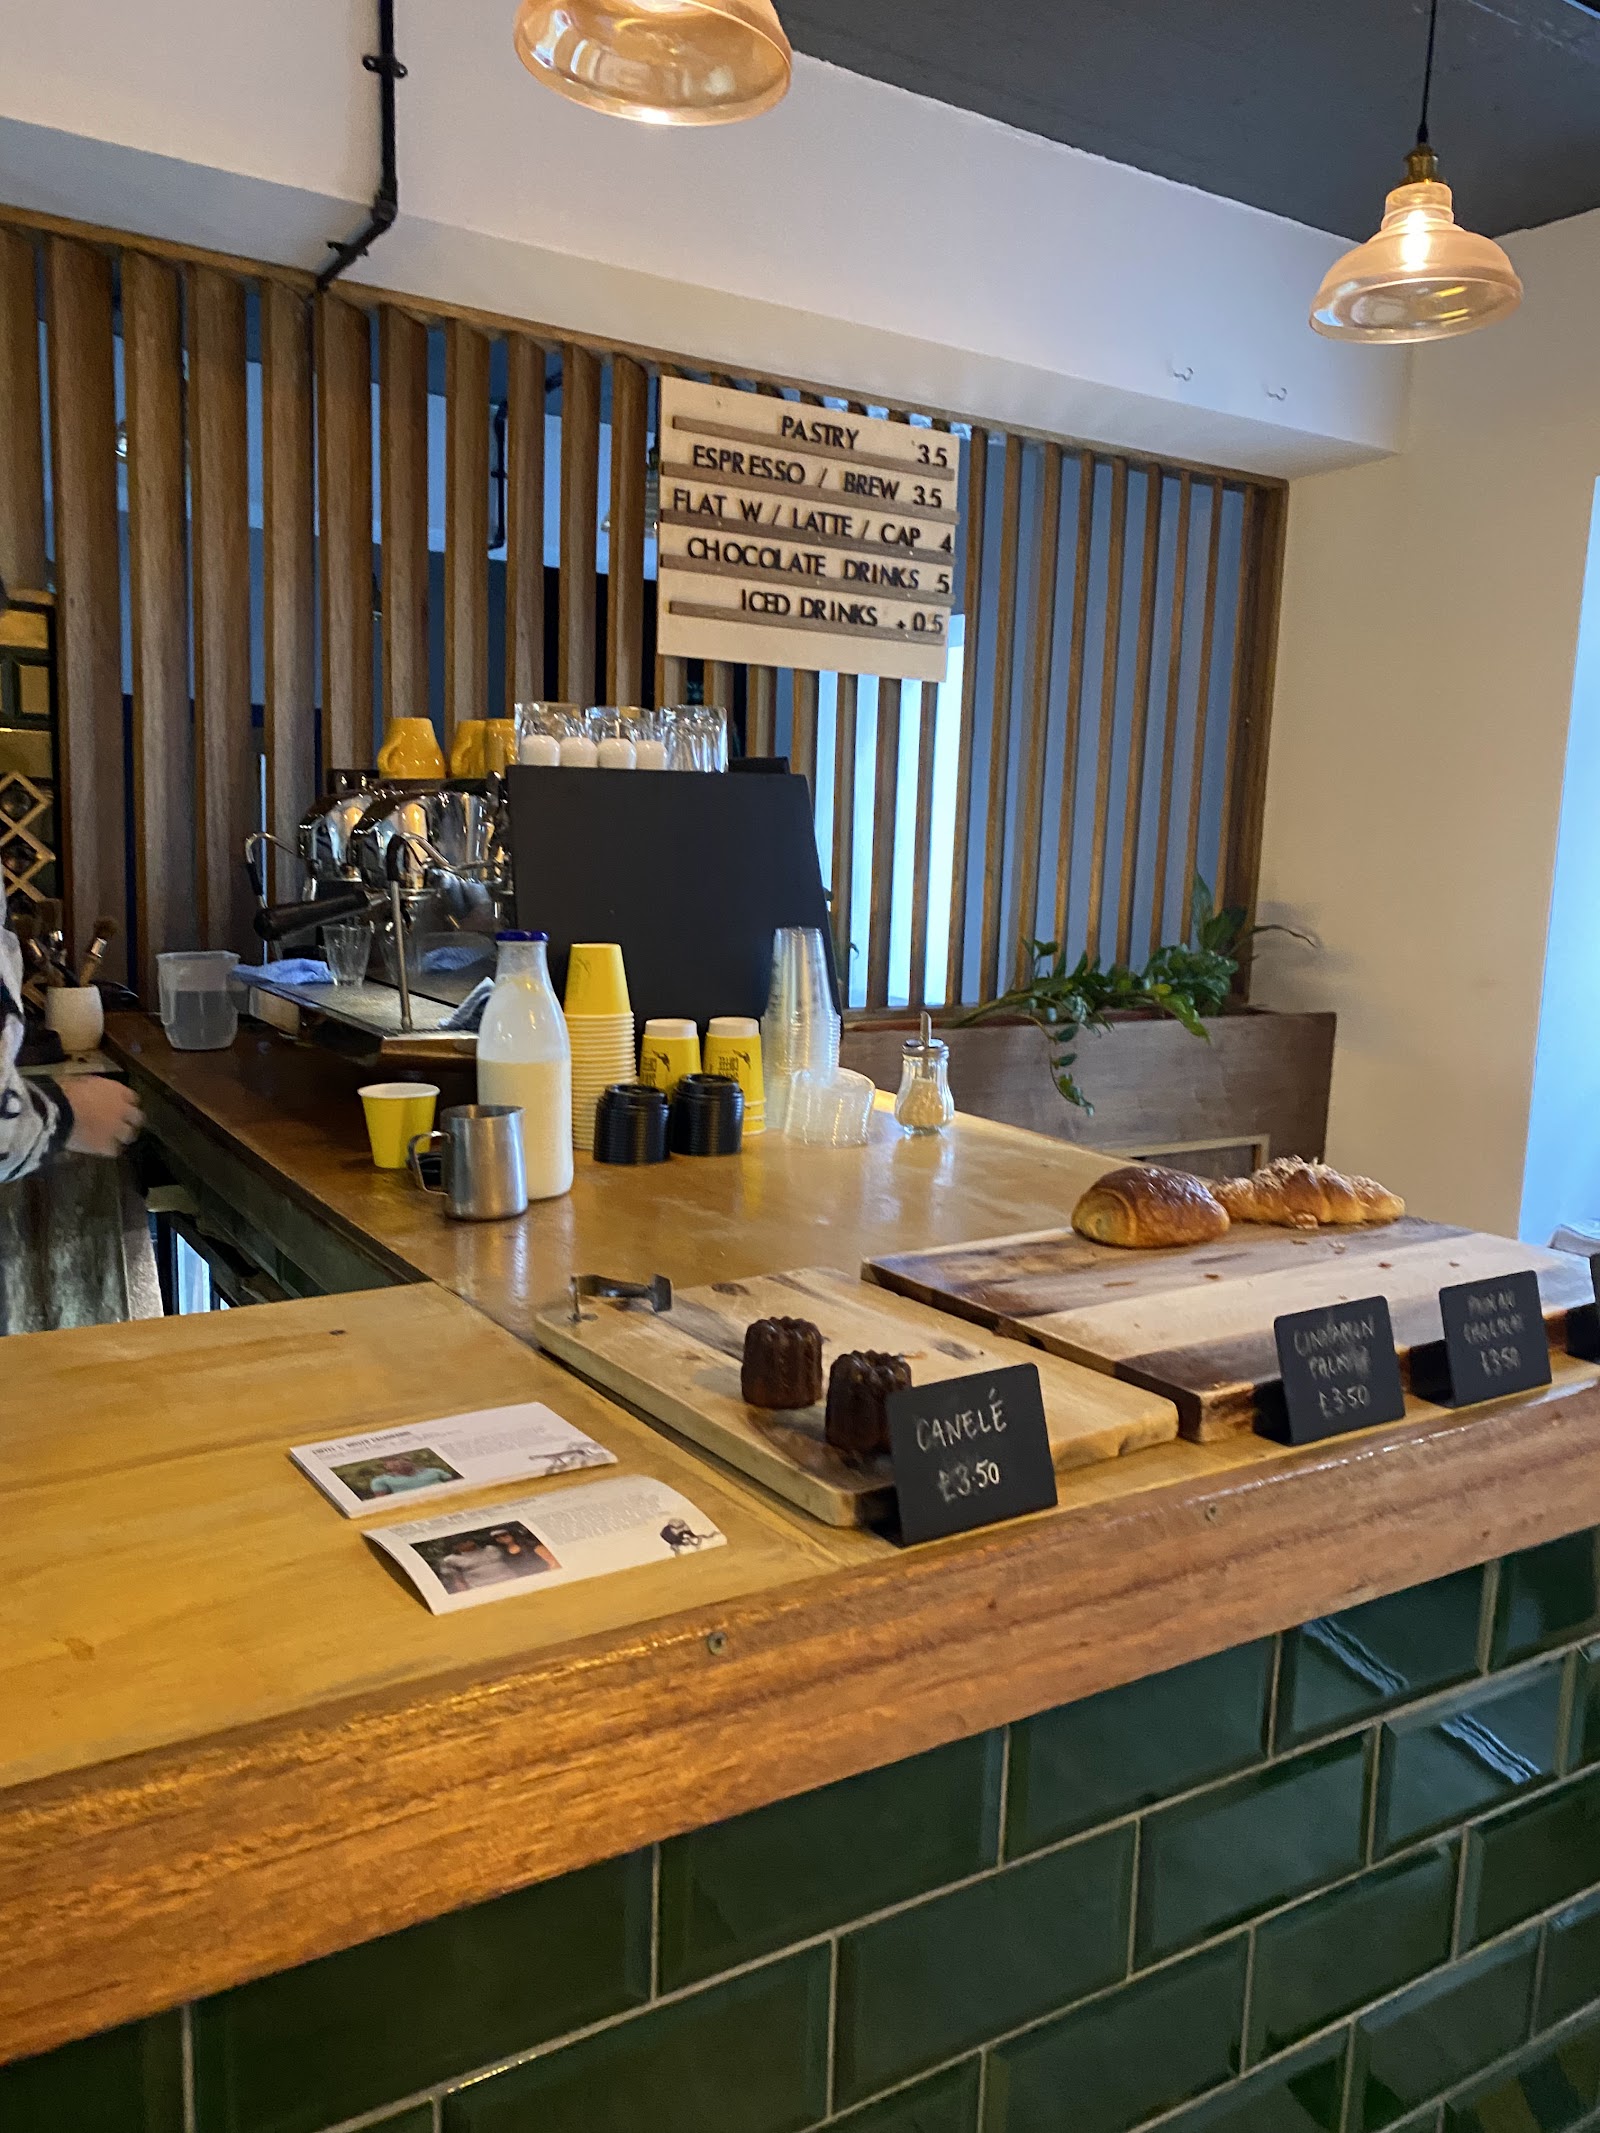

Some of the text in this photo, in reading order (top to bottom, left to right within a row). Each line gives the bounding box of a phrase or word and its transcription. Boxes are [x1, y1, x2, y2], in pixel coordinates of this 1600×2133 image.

[781, 415, 860, 450] PASTRY
[693, 444, 806, 485] ESPRESSO
[843, 471, 900, 501] BREW
[673, 487, 728, 517] FLAT
[792, 508, 853, 538] LATTE
[880, 523, 921, 548] CAP
[940, 533, 952, 553] 4
[687, 537, 950, 595] CHOCOLATE DRINKS 5
[741, 588, 791, 616] ICED
[800, 597, 878, 627] DRINKS
[916, 1387, 1008, 1453] CANELÉ
